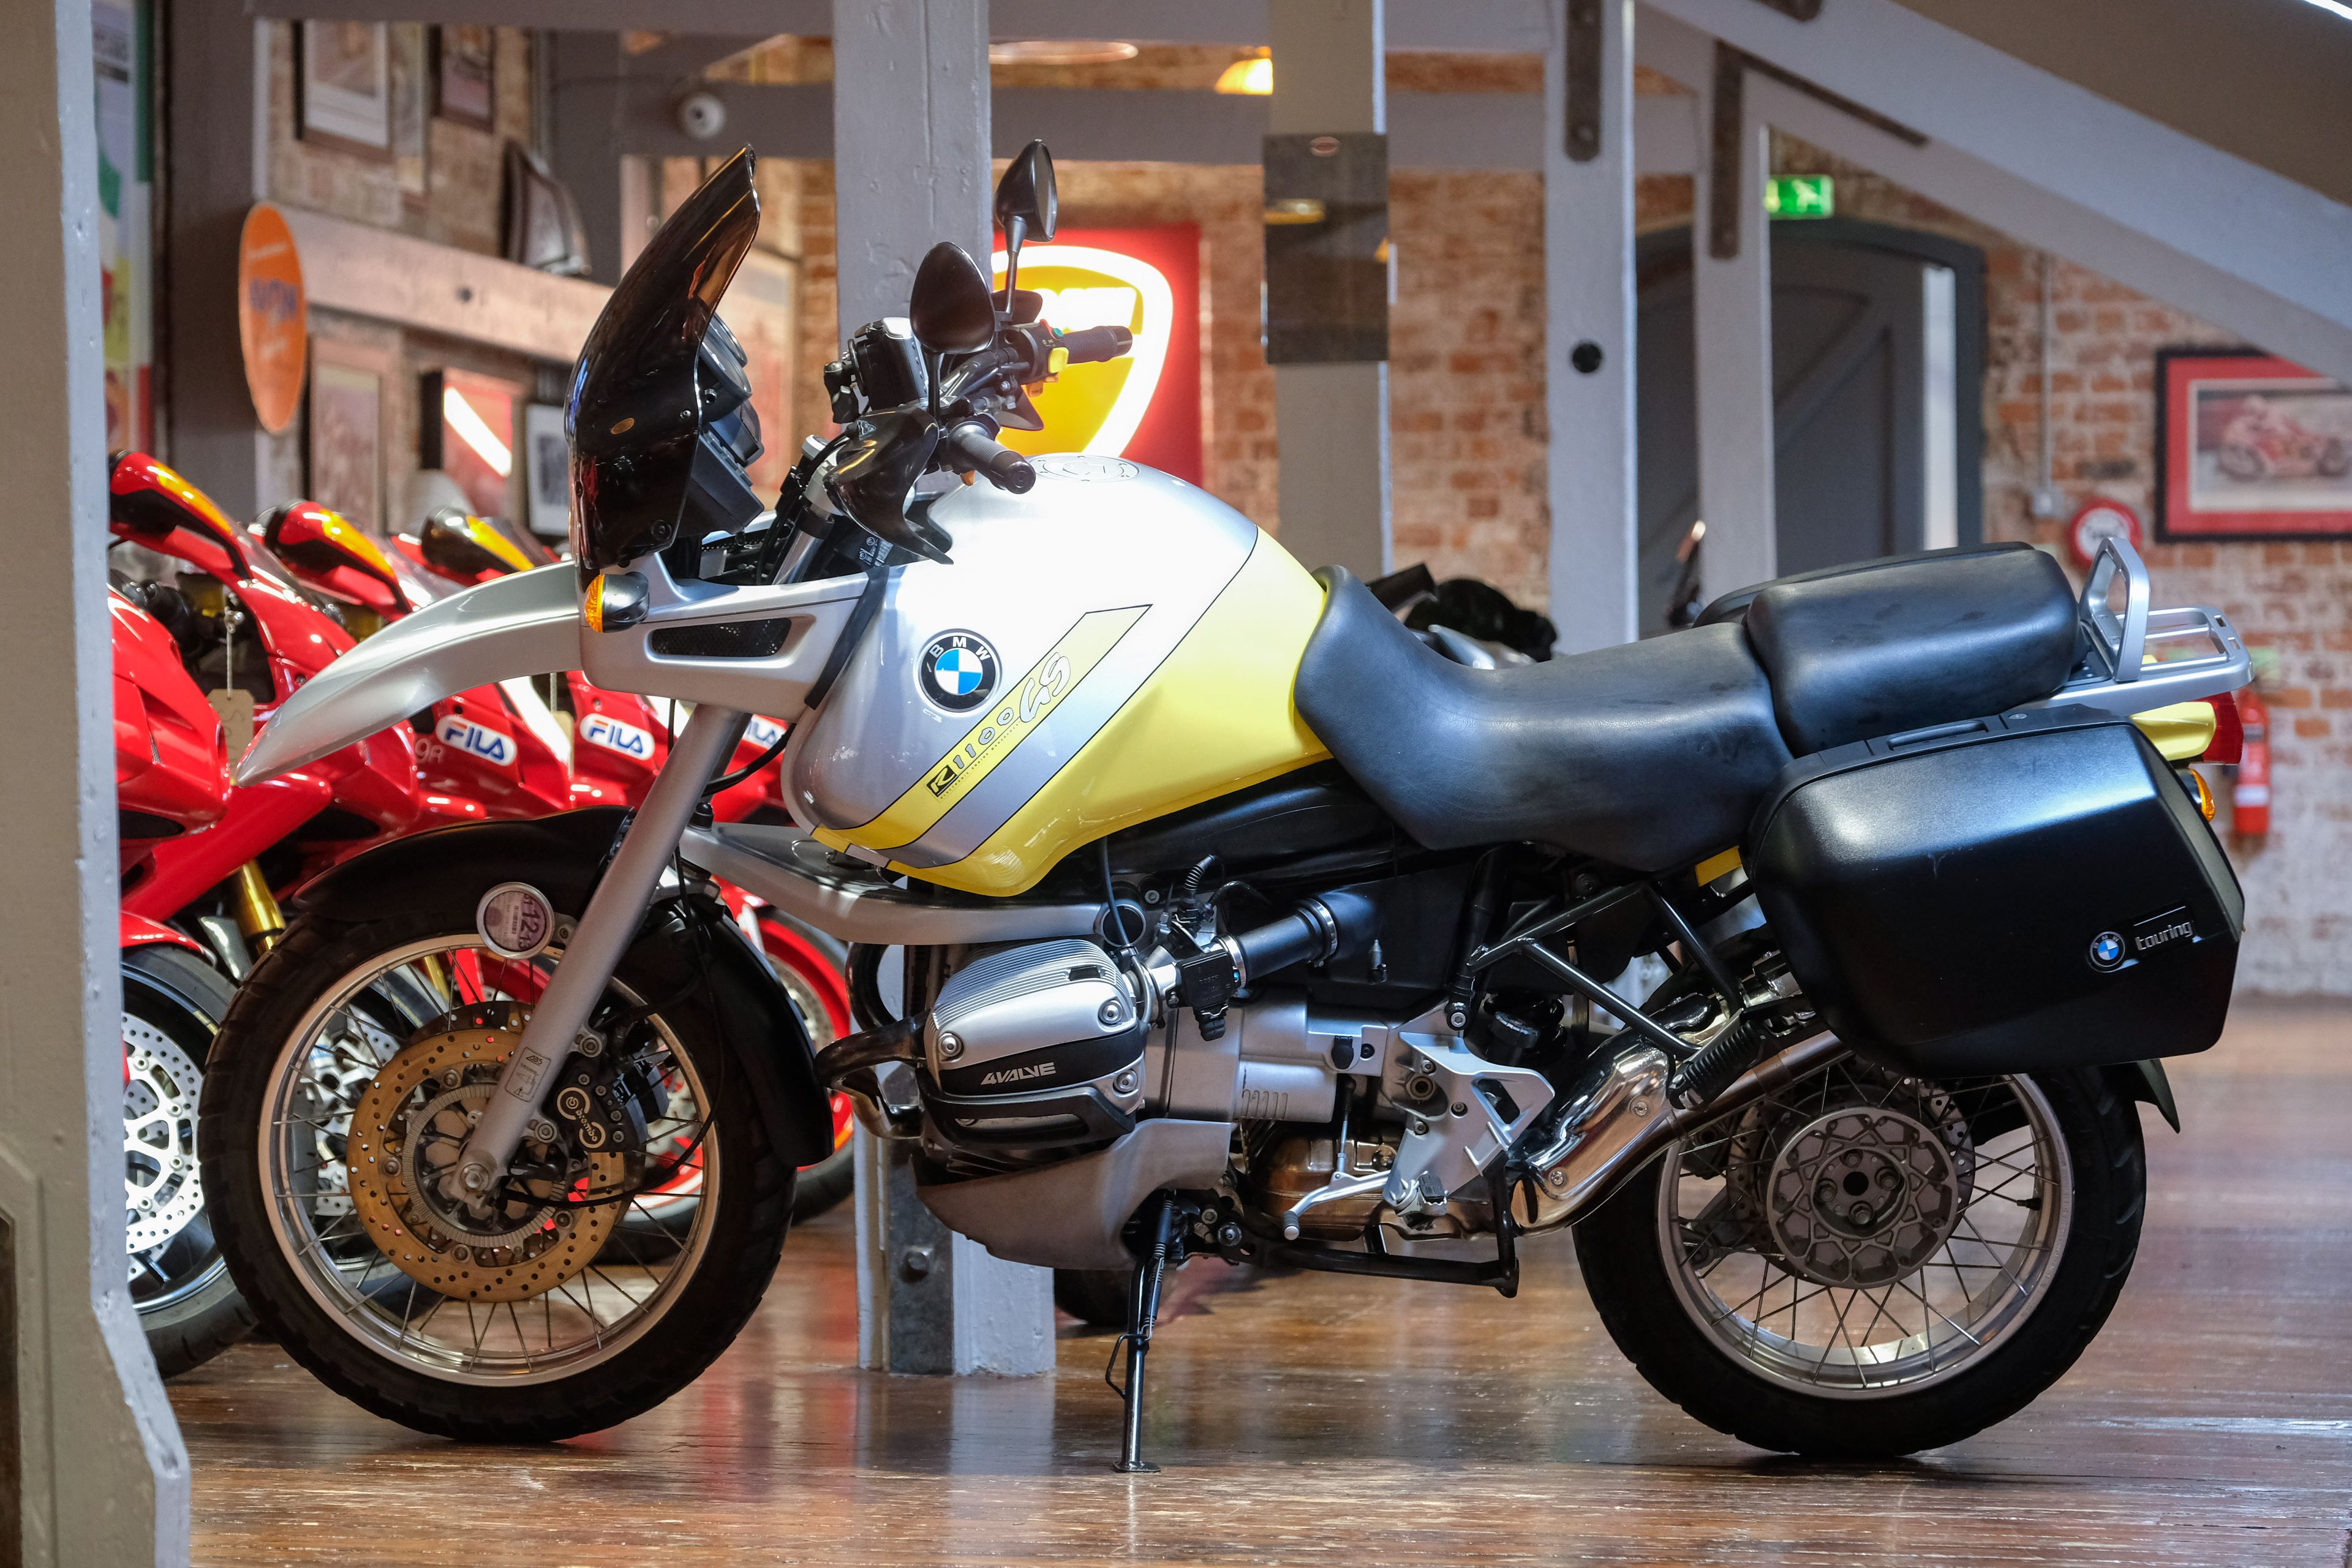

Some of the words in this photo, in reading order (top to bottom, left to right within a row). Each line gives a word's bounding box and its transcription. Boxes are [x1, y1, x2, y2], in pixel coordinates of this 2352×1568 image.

[929, 636, 991, 661] BMW
[444, 720, 504, 760] FILA
[589, 720, 643, 753] FILA
[747, 720, 776, 745] ILA
[521, 910, 540, 933] 12
[2093, 935, 2120, 949] BMW
[2135, 921, 2193, 951] touring
[576, 1108, 598, 1142] brembo
